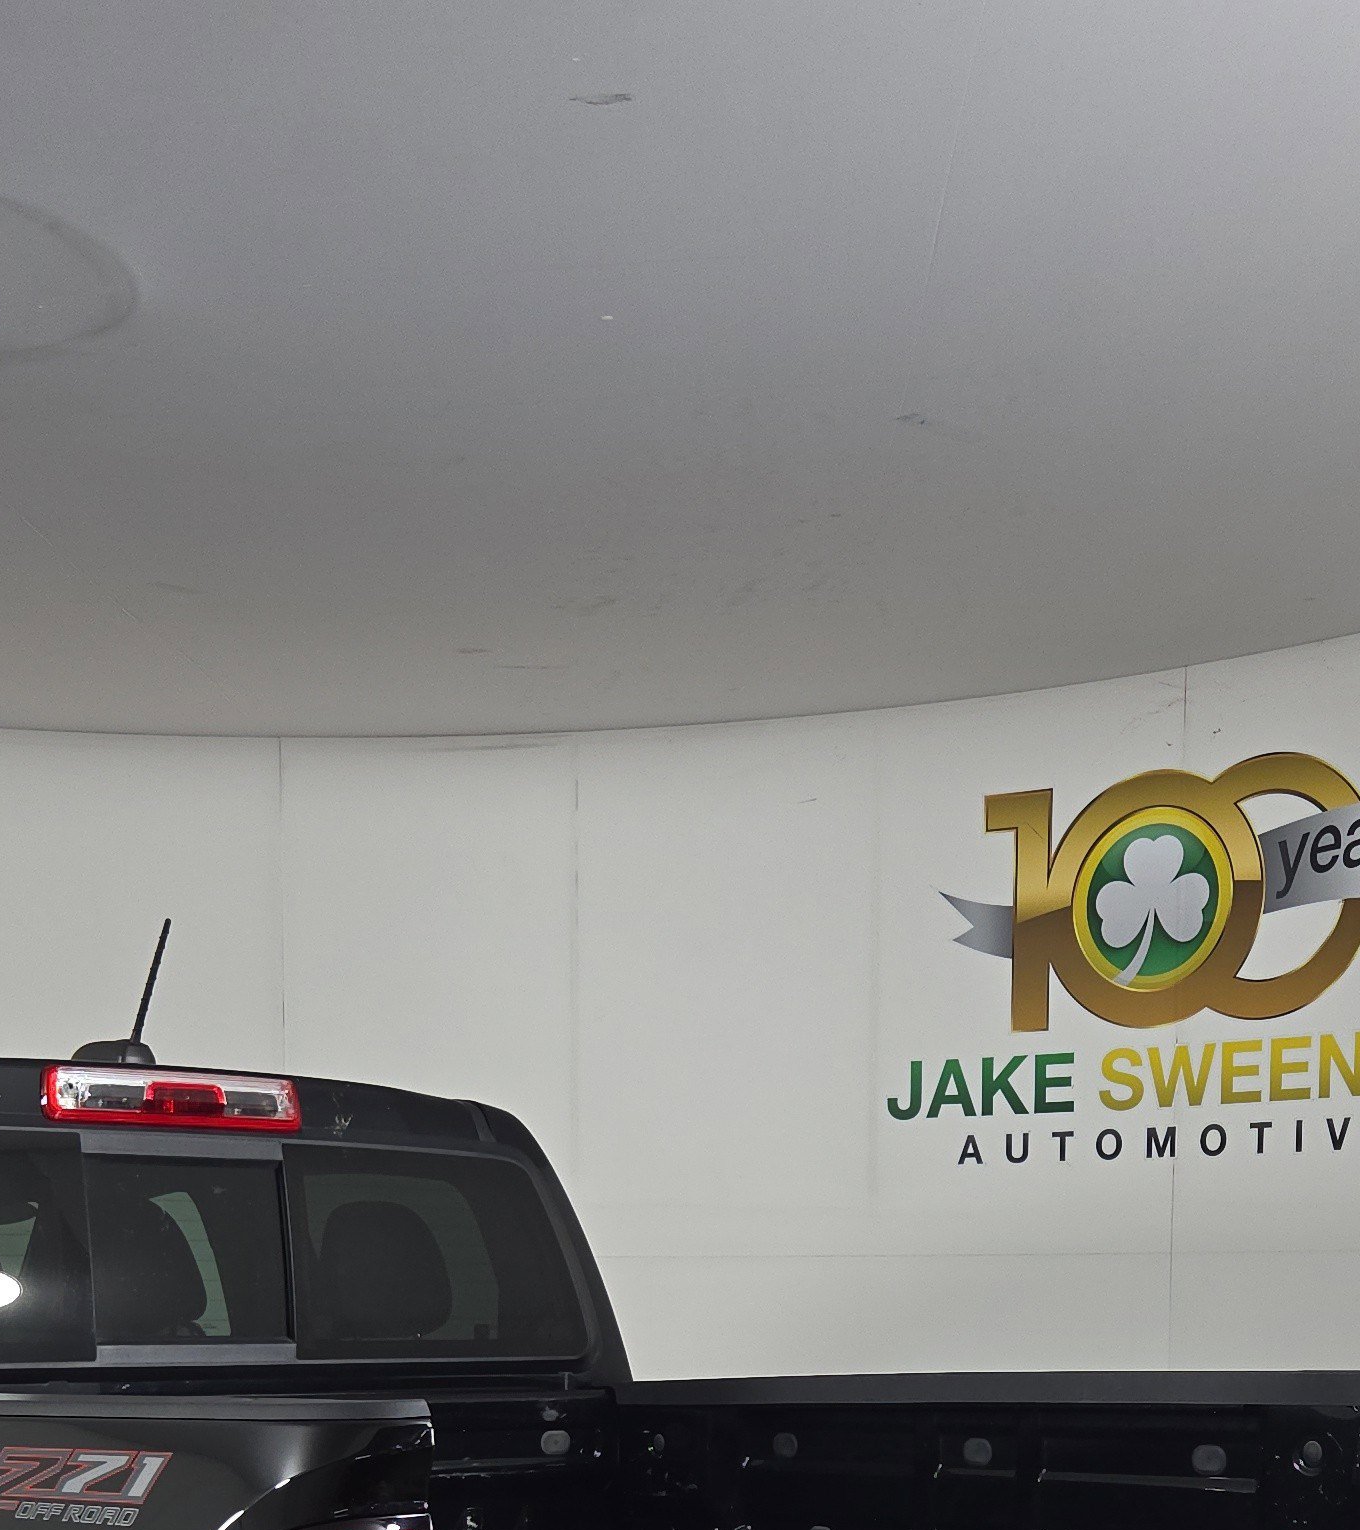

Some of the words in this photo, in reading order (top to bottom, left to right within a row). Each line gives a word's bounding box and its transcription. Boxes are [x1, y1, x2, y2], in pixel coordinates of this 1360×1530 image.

[887, 1052, 1075, 1120] JAKE
[15, 1501, 65, 1520] OFF
[62, 1504, 139, 1526] ROAD
